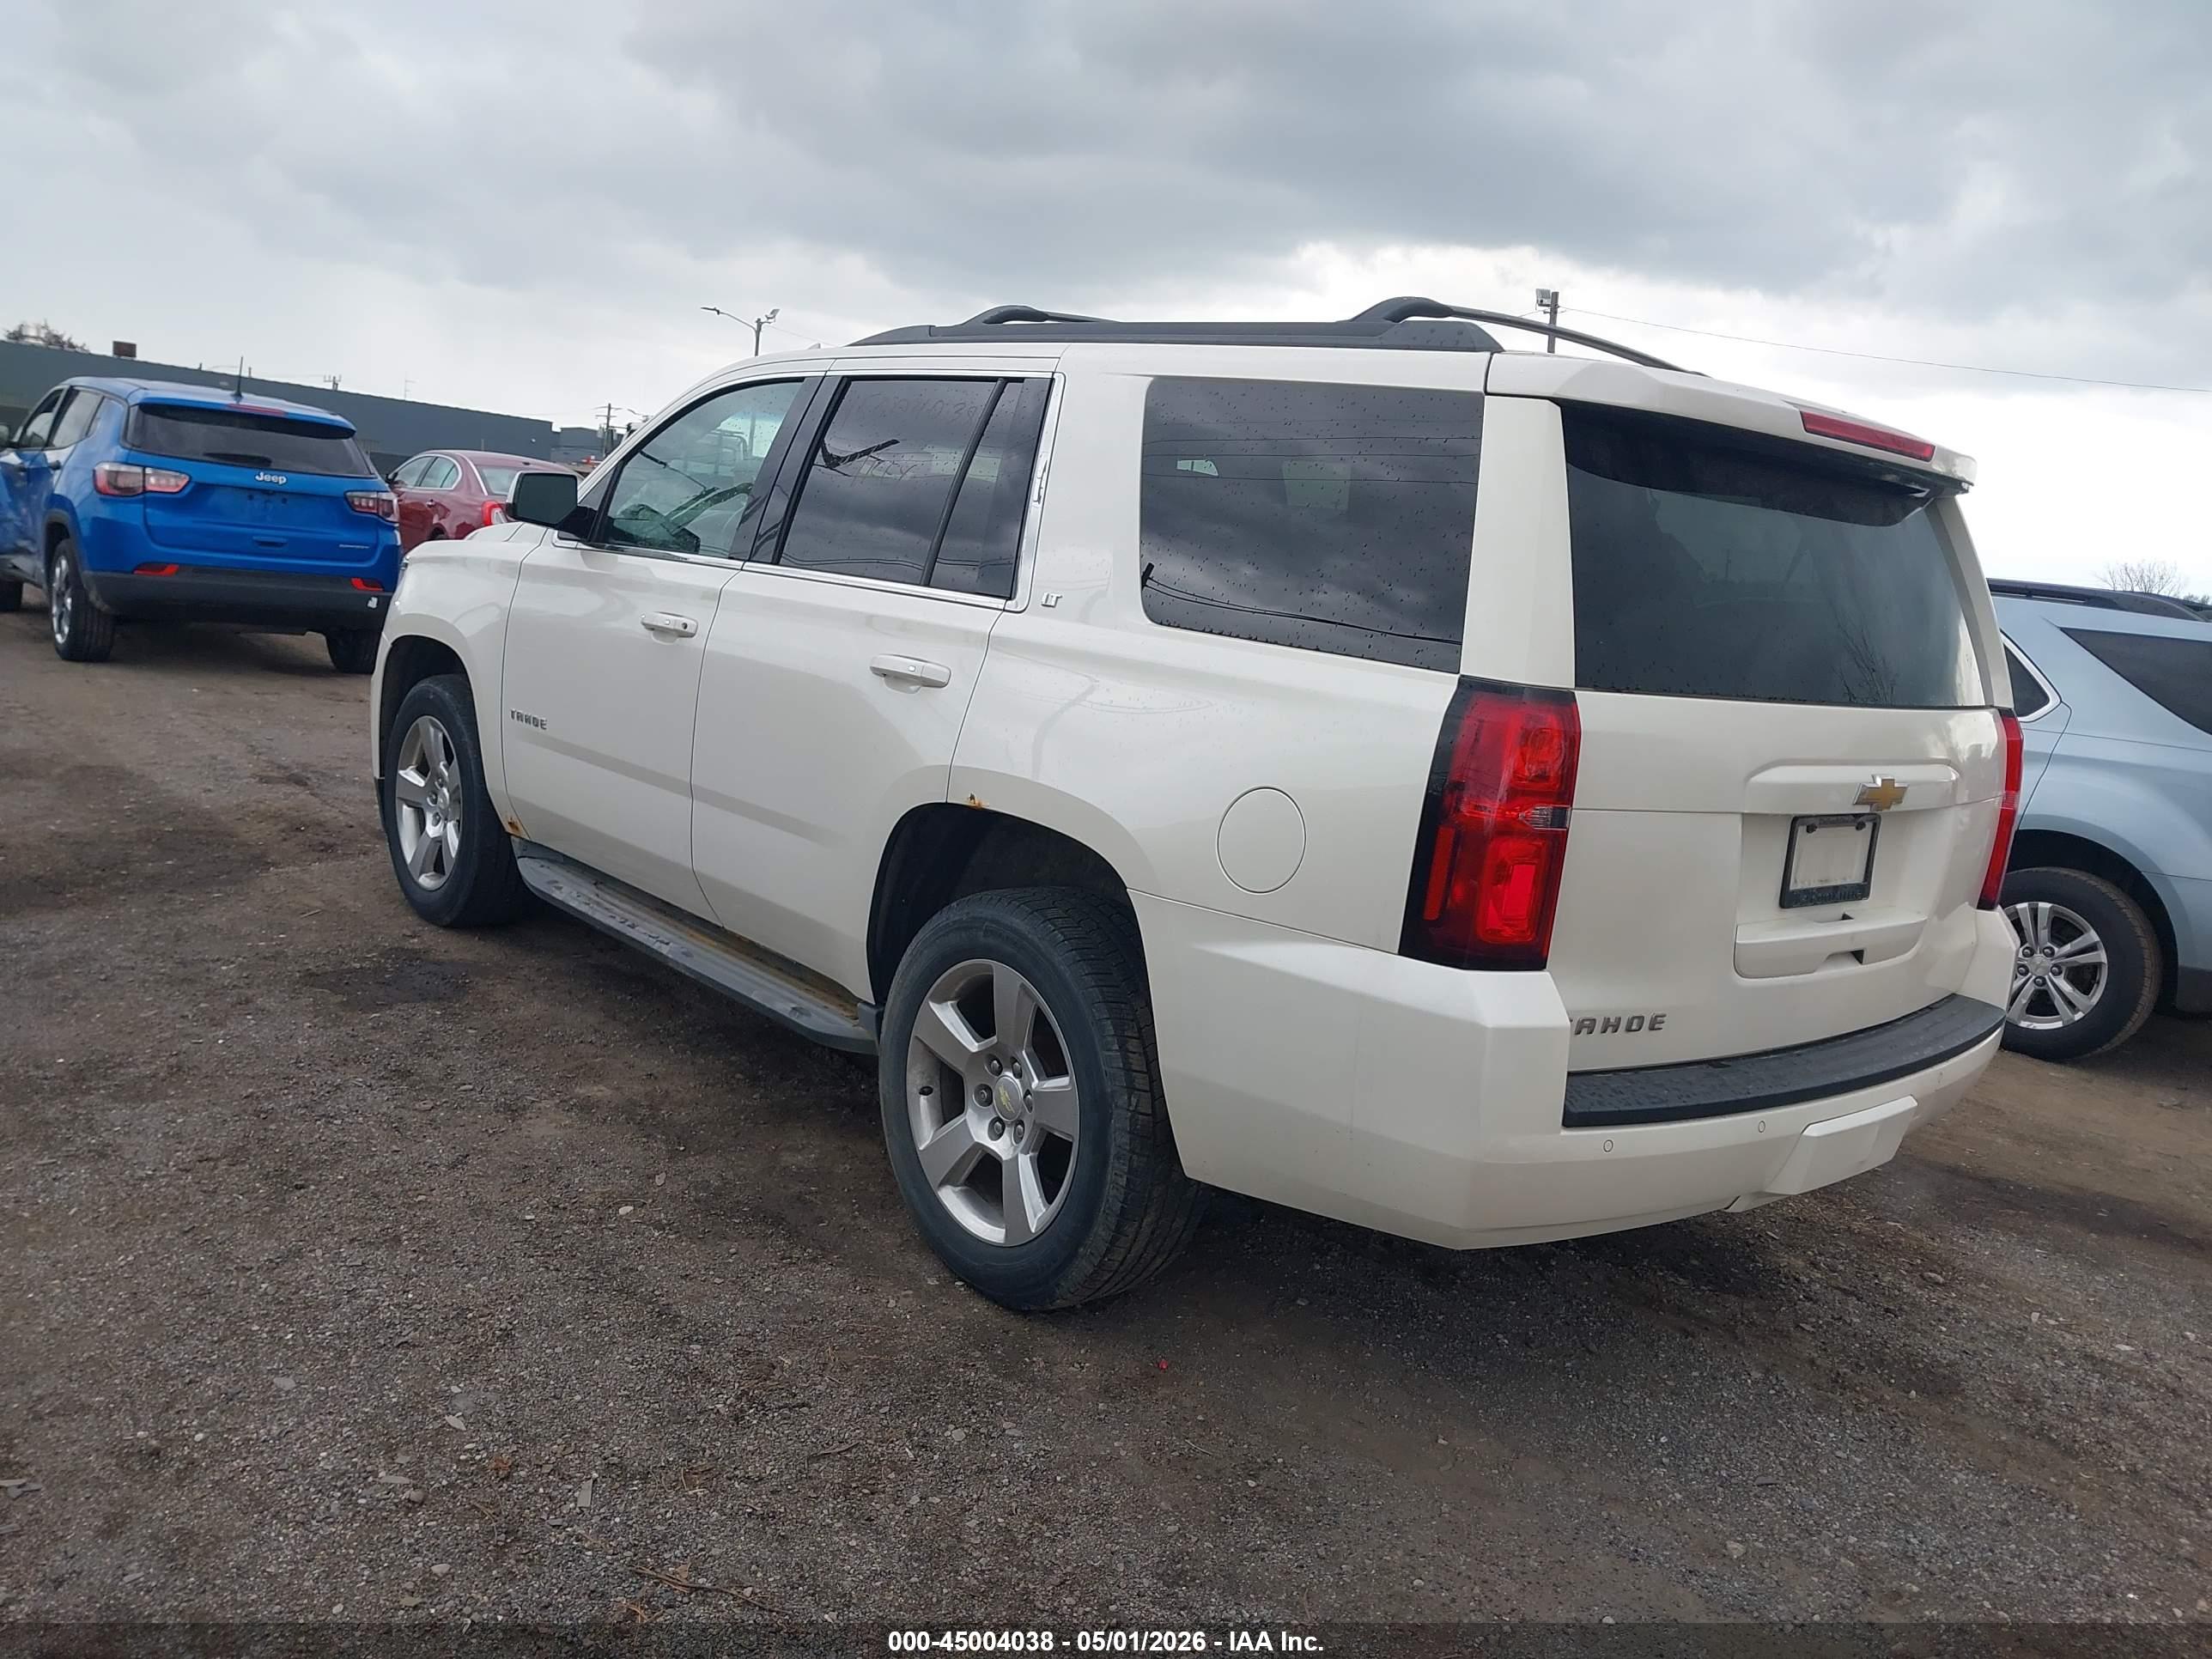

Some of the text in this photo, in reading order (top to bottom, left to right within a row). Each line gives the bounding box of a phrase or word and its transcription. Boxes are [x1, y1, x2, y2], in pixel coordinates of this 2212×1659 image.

[255, 471, 288, 485] Jeep
[1041, 592, 1062, 608] LT
[510, 709, 547, 730] TAHOE
[1571, 1013, 1667, 1035] AHOE
